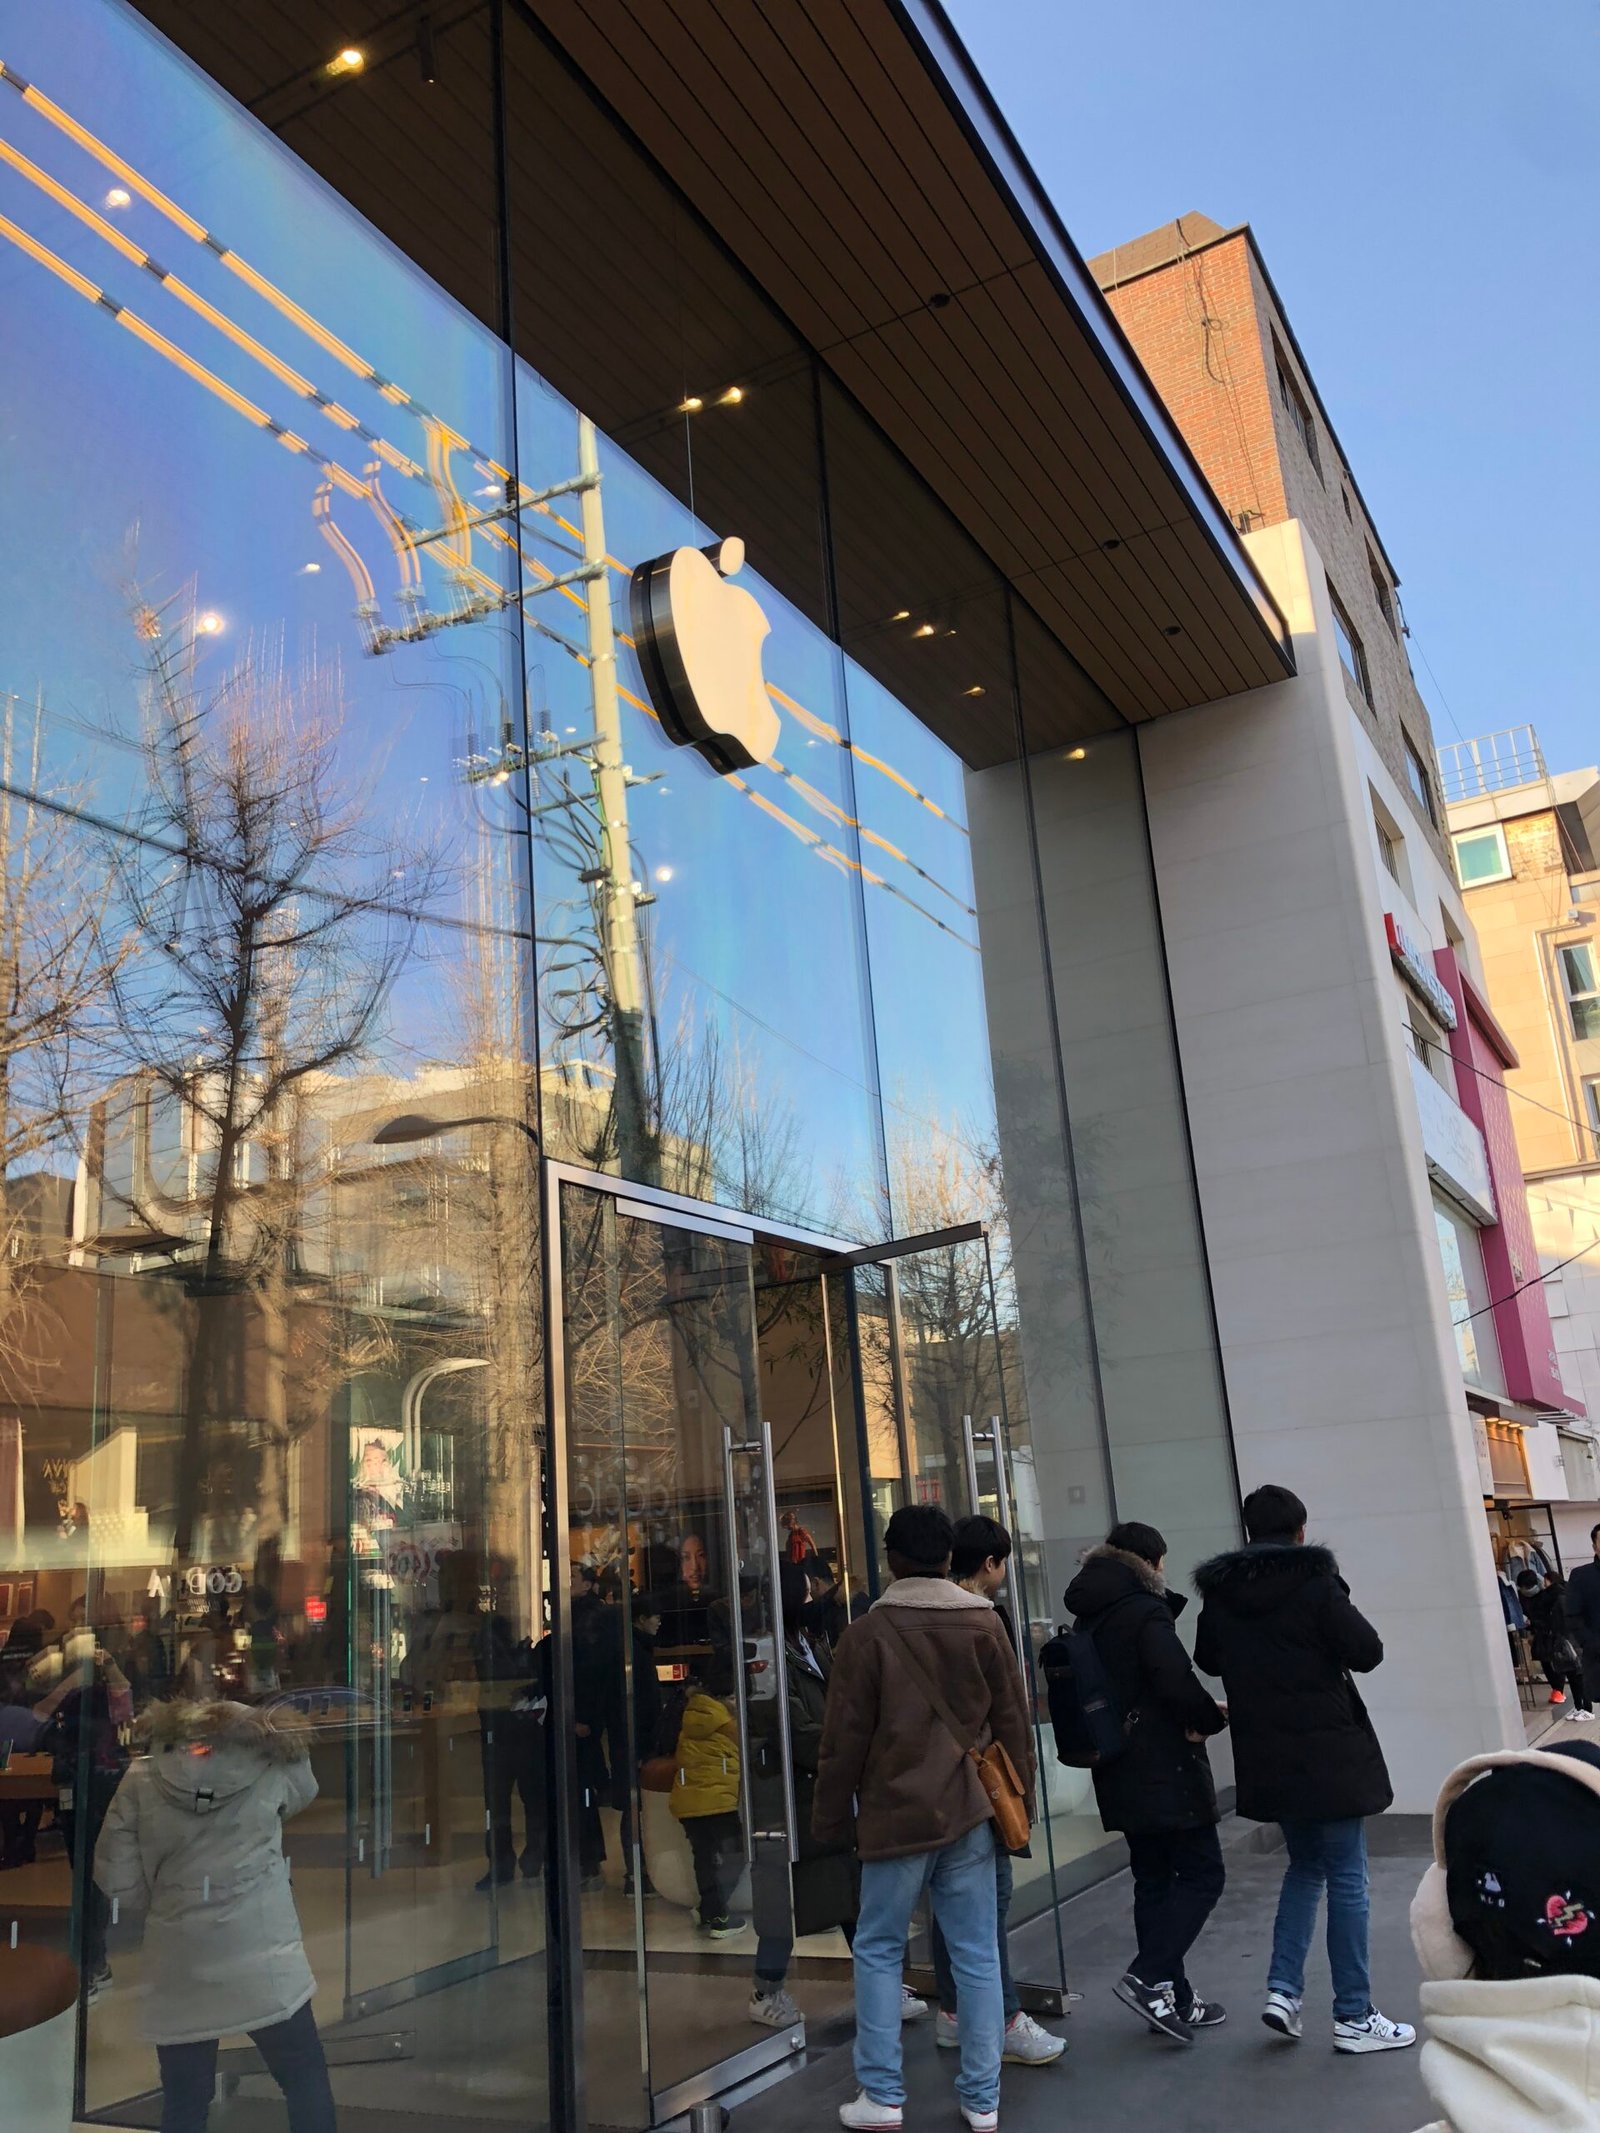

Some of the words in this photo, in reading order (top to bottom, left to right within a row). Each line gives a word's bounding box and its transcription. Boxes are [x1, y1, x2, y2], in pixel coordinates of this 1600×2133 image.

[1148, 1999, 1172, 2018] N
[1187, 2007, 1206, 2023] N
[1374, 2023, 1389, 2038] N
